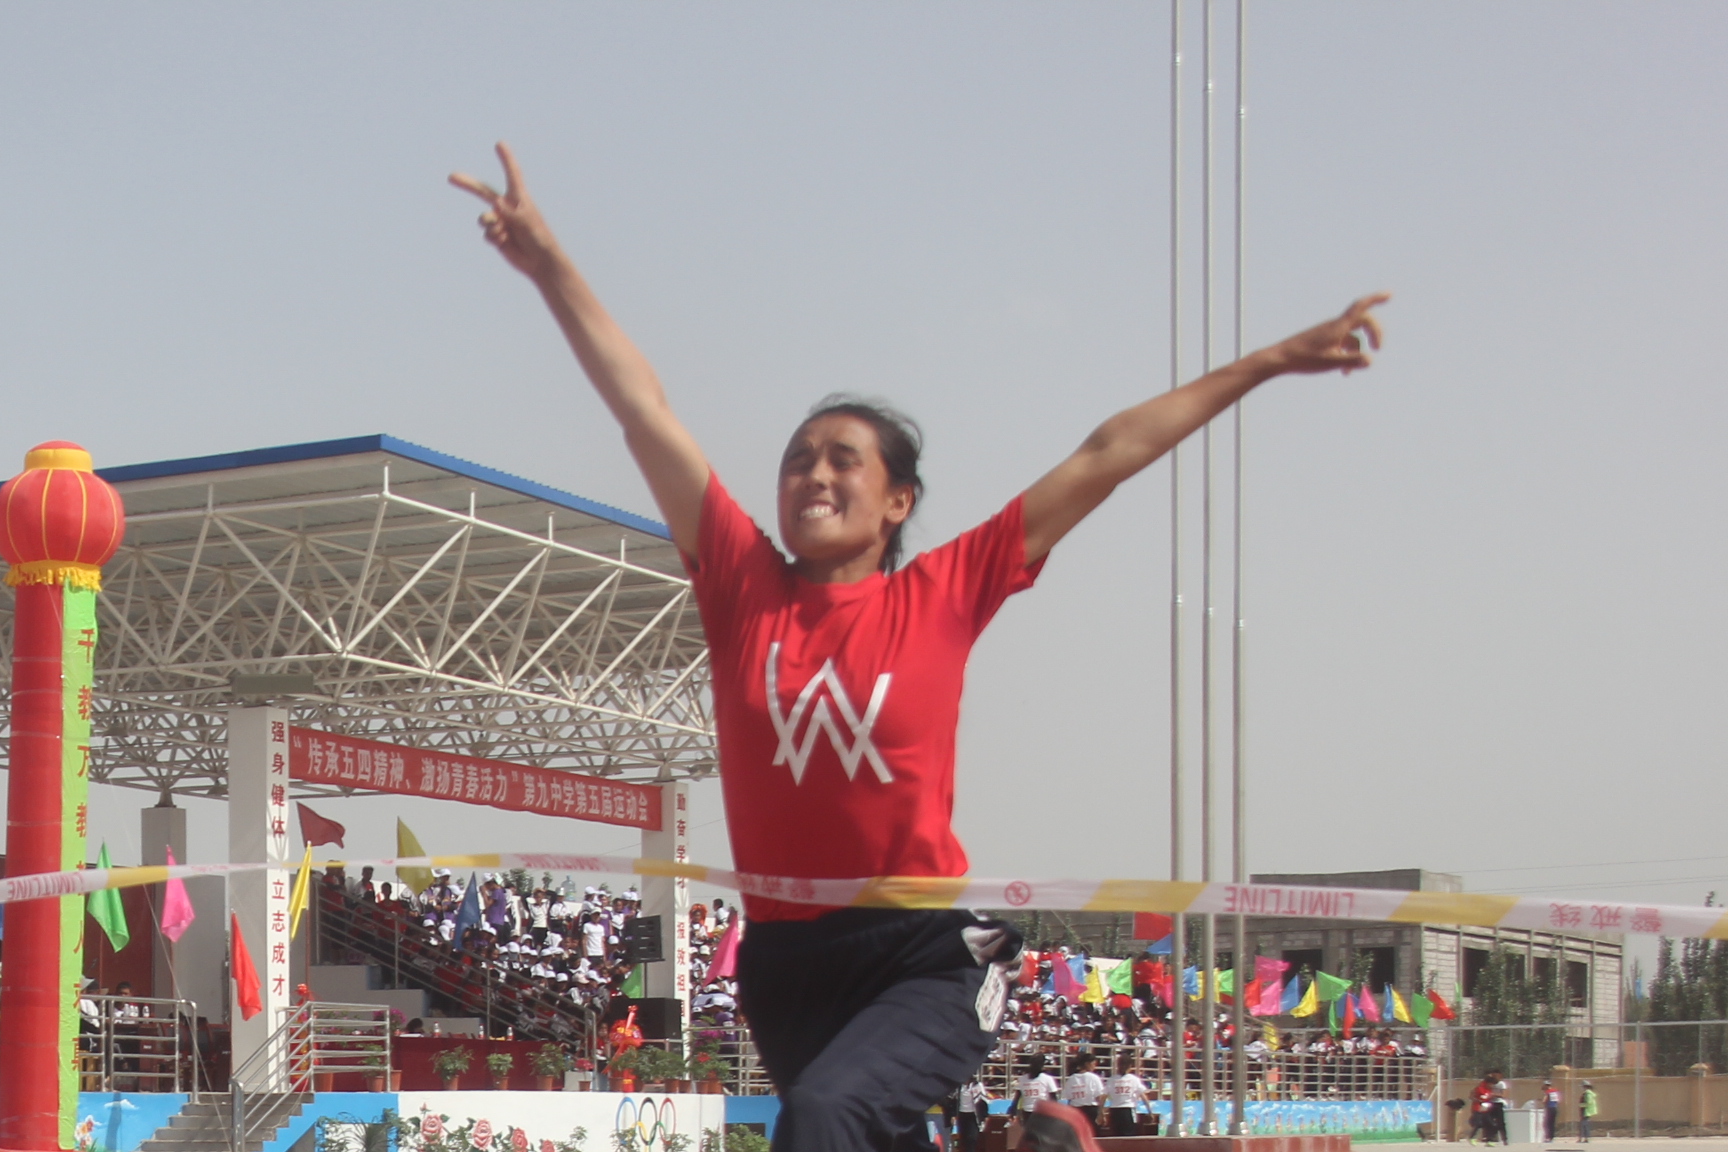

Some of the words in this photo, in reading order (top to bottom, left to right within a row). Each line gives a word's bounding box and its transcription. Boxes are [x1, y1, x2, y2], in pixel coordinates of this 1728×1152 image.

[271, 720, 285, 839] 强身健体
[272, 879, 286, 996] 立志成才
[1223, 885, 1354, 917] LIMITLINE
[1548, 902, 1664, 934] 警戒线
